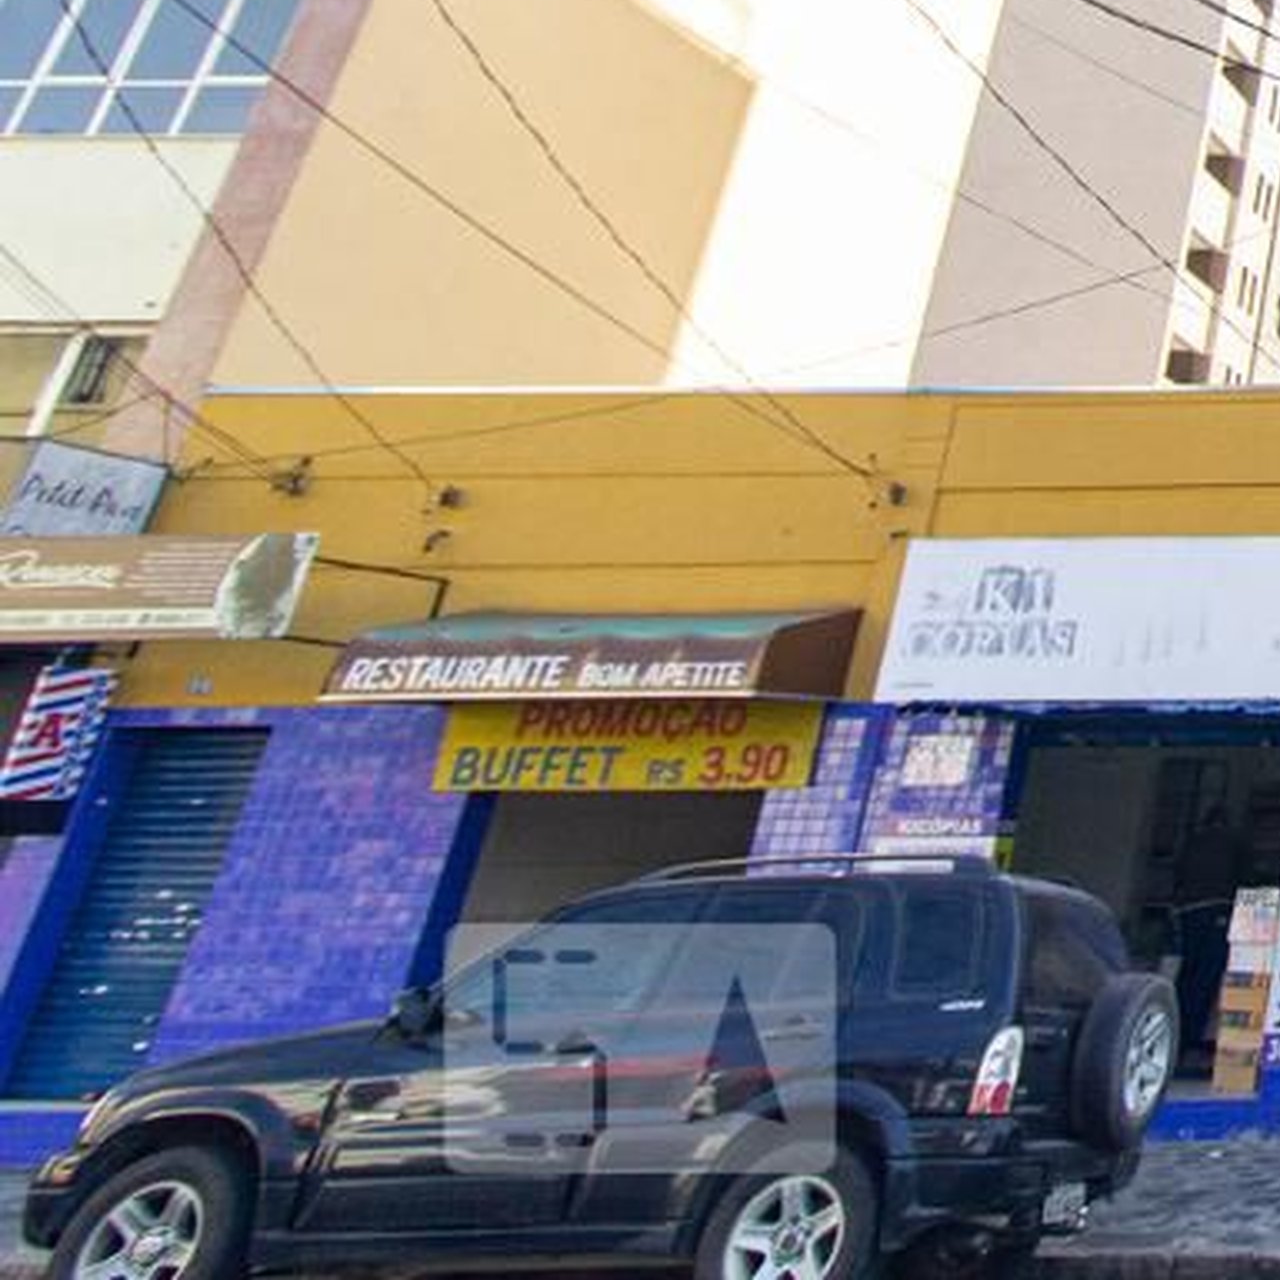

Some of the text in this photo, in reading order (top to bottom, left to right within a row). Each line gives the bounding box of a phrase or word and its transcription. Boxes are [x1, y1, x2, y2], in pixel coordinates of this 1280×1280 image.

[341, 655, 747, 690] RESTAURANTE BOM APETITE
[450, 746, 625, 787] BUFFET
[699, 744, 790, 786] 3.90
